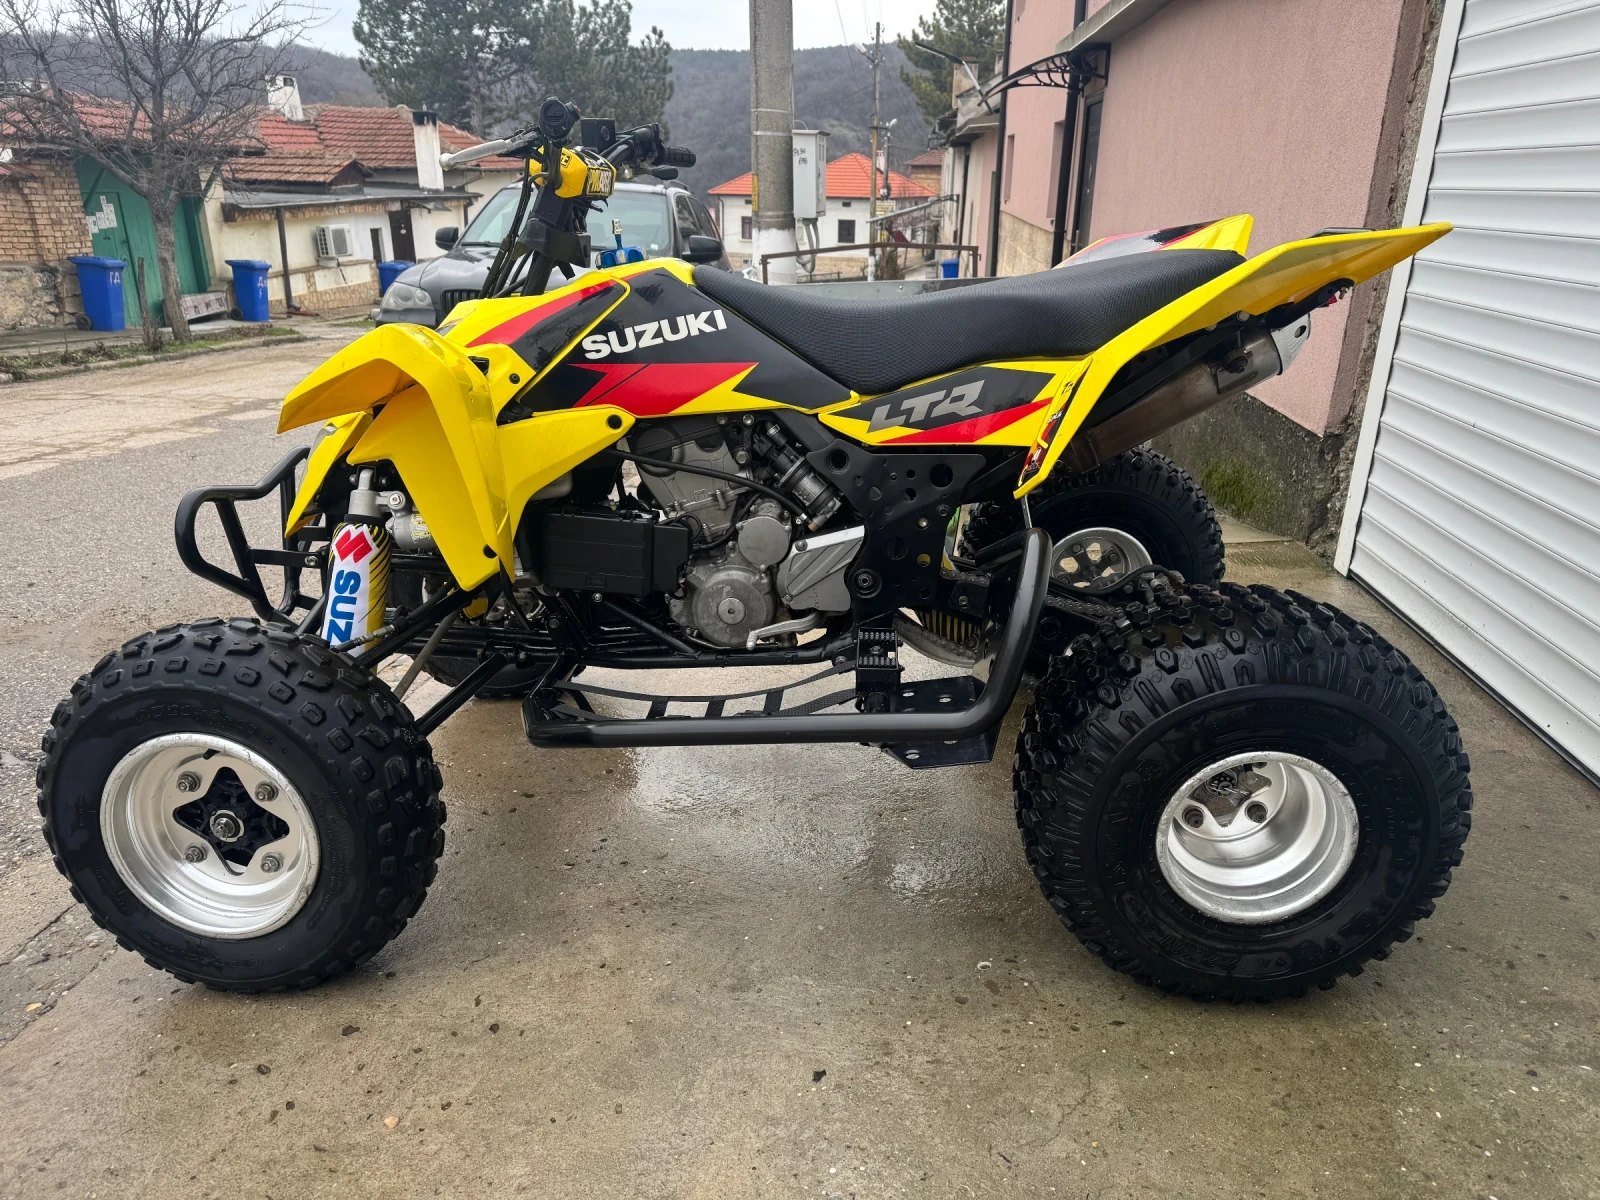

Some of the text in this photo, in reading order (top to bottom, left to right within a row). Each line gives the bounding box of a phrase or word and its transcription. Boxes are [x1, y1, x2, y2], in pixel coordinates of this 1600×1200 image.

[581, 309, 728, 360] SUZUKI
[866, 379, 986, 434] LTR
[326, 569, 362, 648] SUZ
